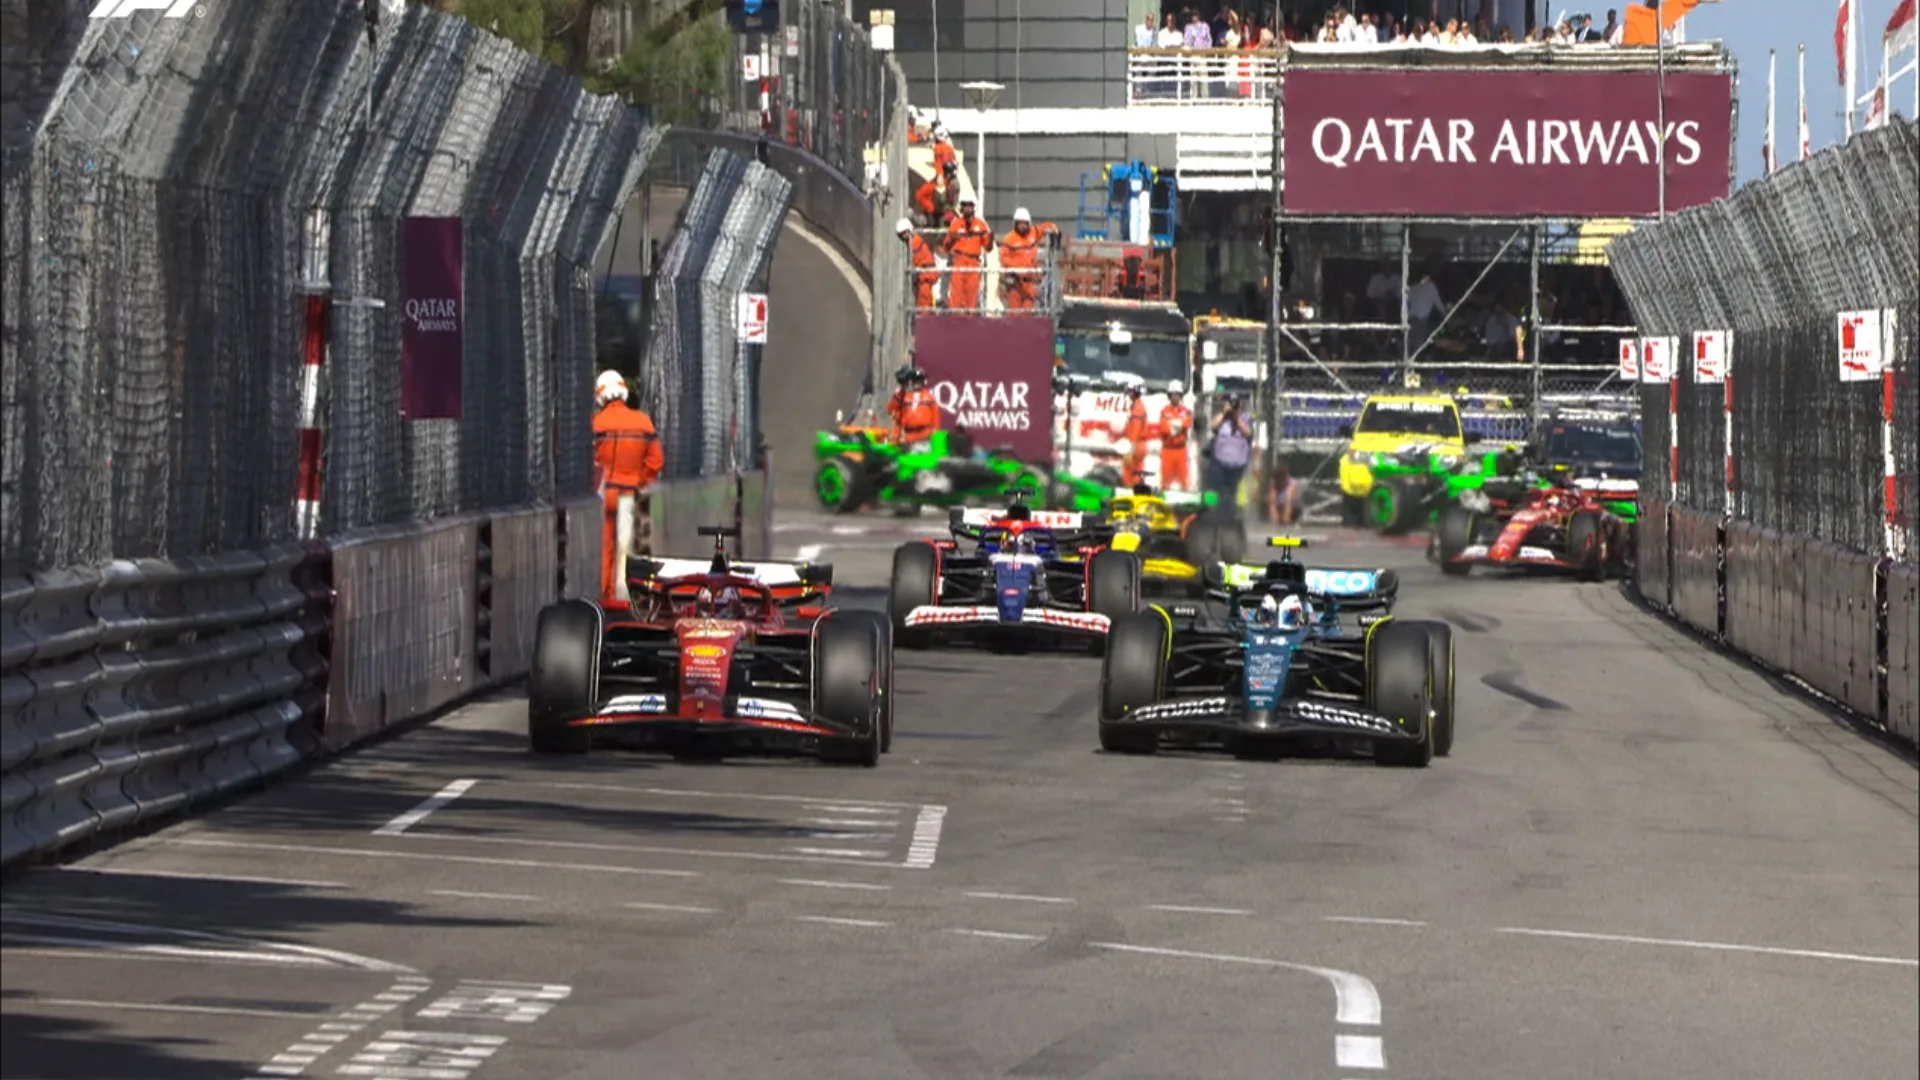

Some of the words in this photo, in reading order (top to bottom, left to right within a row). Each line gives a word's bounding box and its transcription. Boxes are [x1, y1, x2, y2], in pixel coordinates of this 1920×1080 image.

[1312, 117, 1477, 168] QATAR
[1490, 119, 1701, 165] AIRWAYS
[405, 298, 456, 322] QATAR
[934, 380, 1029, 415] QATAR
[955, 410, 1030, 431] AIRWAYS
[1134, 697, 1226, 720] aramco
[1297, 701, 1392, 733] aramco
